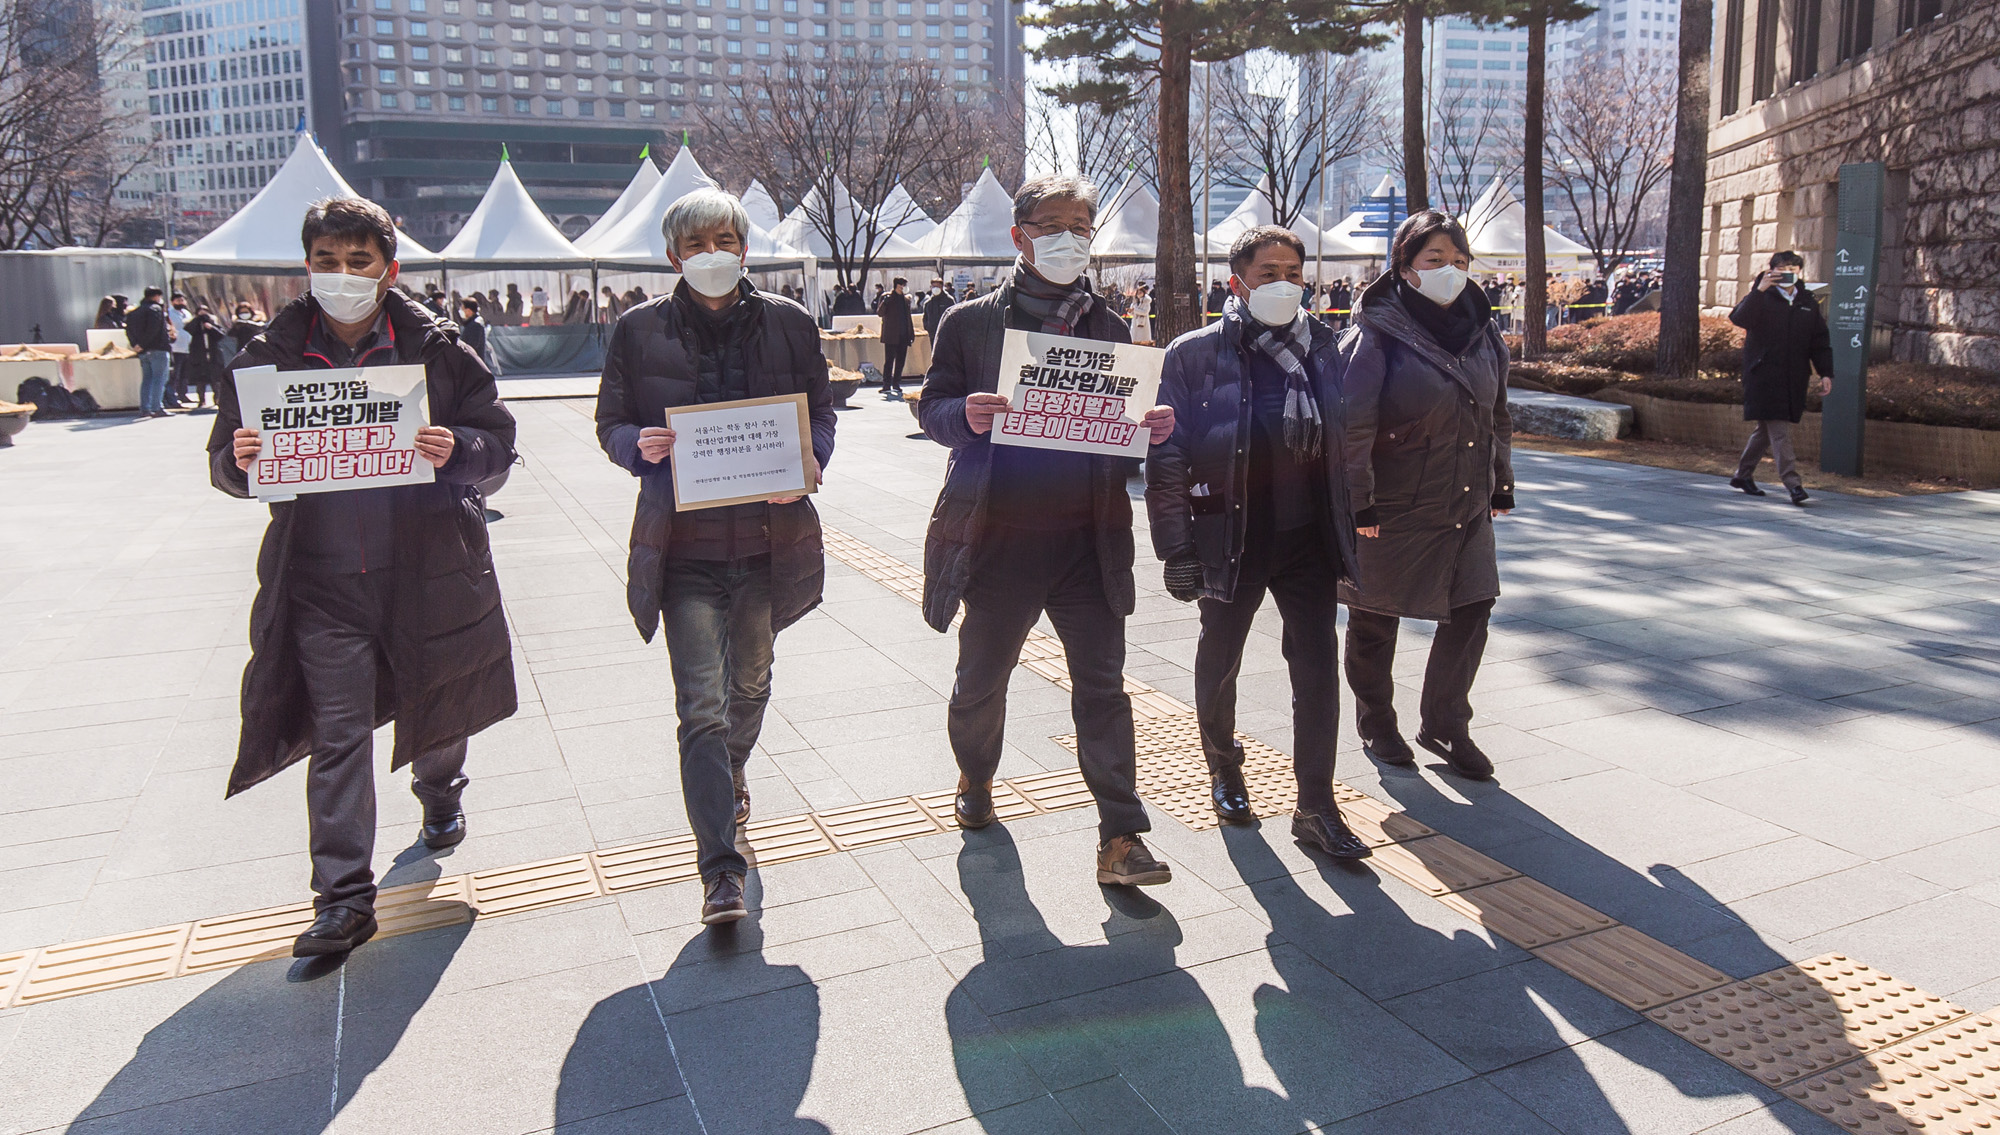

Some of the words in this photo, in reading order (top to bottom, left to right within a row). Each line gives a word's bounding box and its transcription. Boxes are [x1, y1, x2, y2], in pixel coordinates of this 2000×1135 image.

[1045, 346, 1116, 371] 살인기업
[284, 380, 369, 403] 살인기업
[1018, 364, 1139, 397] 현대산업개발
[260, 400, 403, 431] 현대산업개발
[1024, 388, 1126, 420] 엄정처벌과
[273, 425, 396, 459] 엄정처벌과
[694, 425, 723, 435] 서울시는
[726, 423, 741, 431] 학동
[744, 421, 758, 430] 참사
[695, 434, 745, 446] 현대산업개발에
[748, 431, 762, 440] 대해
[765, 430, 779, 438] 가장
[1002, 411, 1066, 439] 퇴출이
[1066, 417, 1138, 447] 답이다!
[692, 449, 713, 458] 강력한
[716, 445, 752, 456] 행정처분을
[755, 441, 785, 451] 실시하라!
[258, 455, 327, 485] 퇴출이
[331, 450, 415, 480] 답이다!
